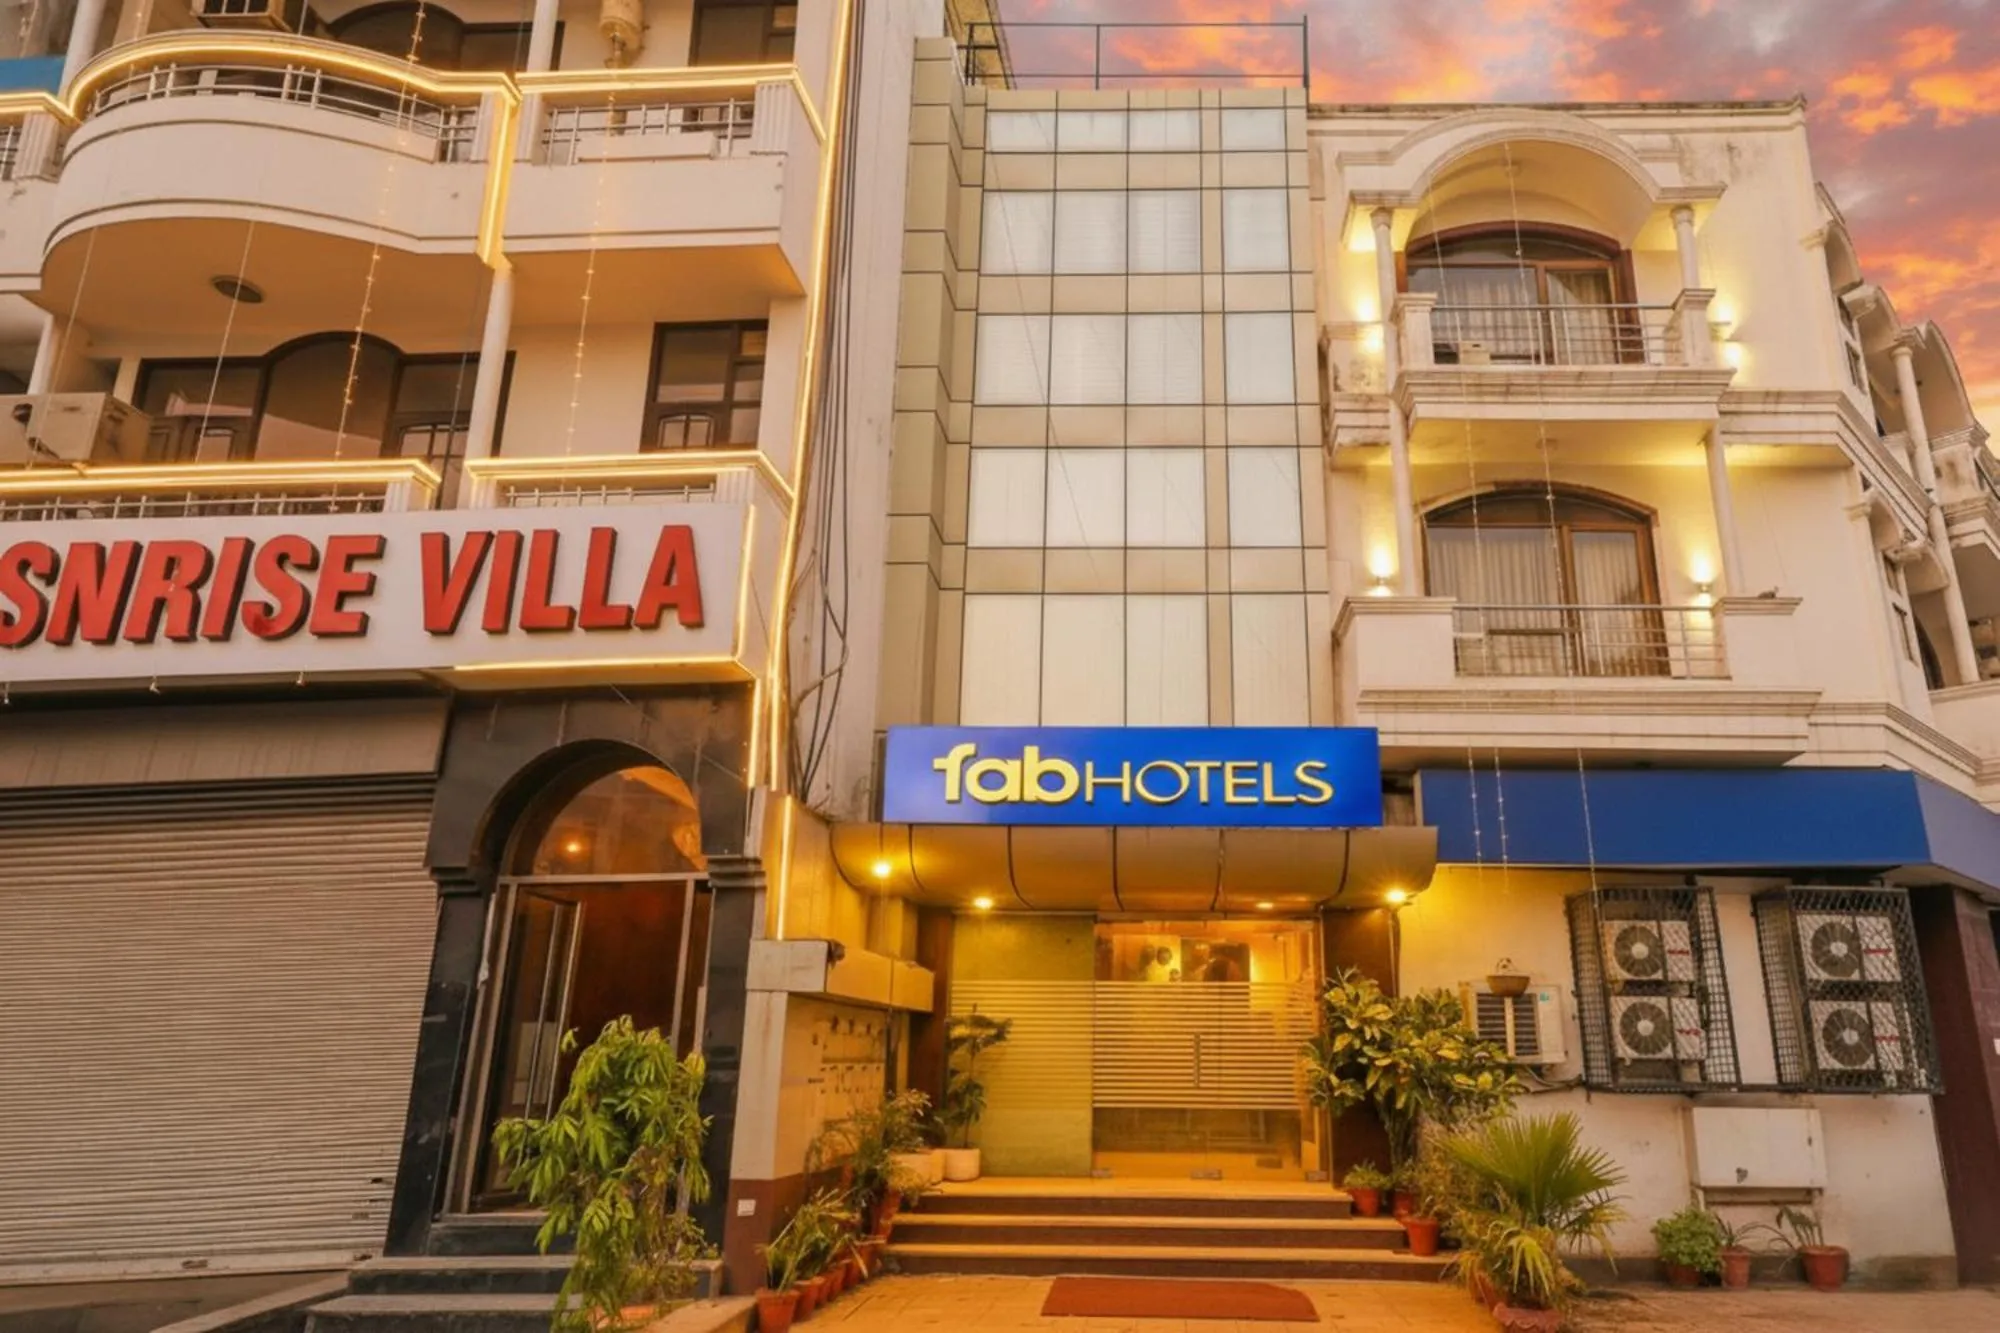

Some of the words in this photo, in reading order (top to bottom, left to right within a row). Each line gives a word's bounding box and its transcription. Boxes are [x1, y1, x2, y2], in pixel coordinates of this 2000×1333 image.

[0, 534, 385, 646] SNRISE
[420, 524, 705, 634] VILLA
[933, 743, 1335, 804] fabHOTELS
